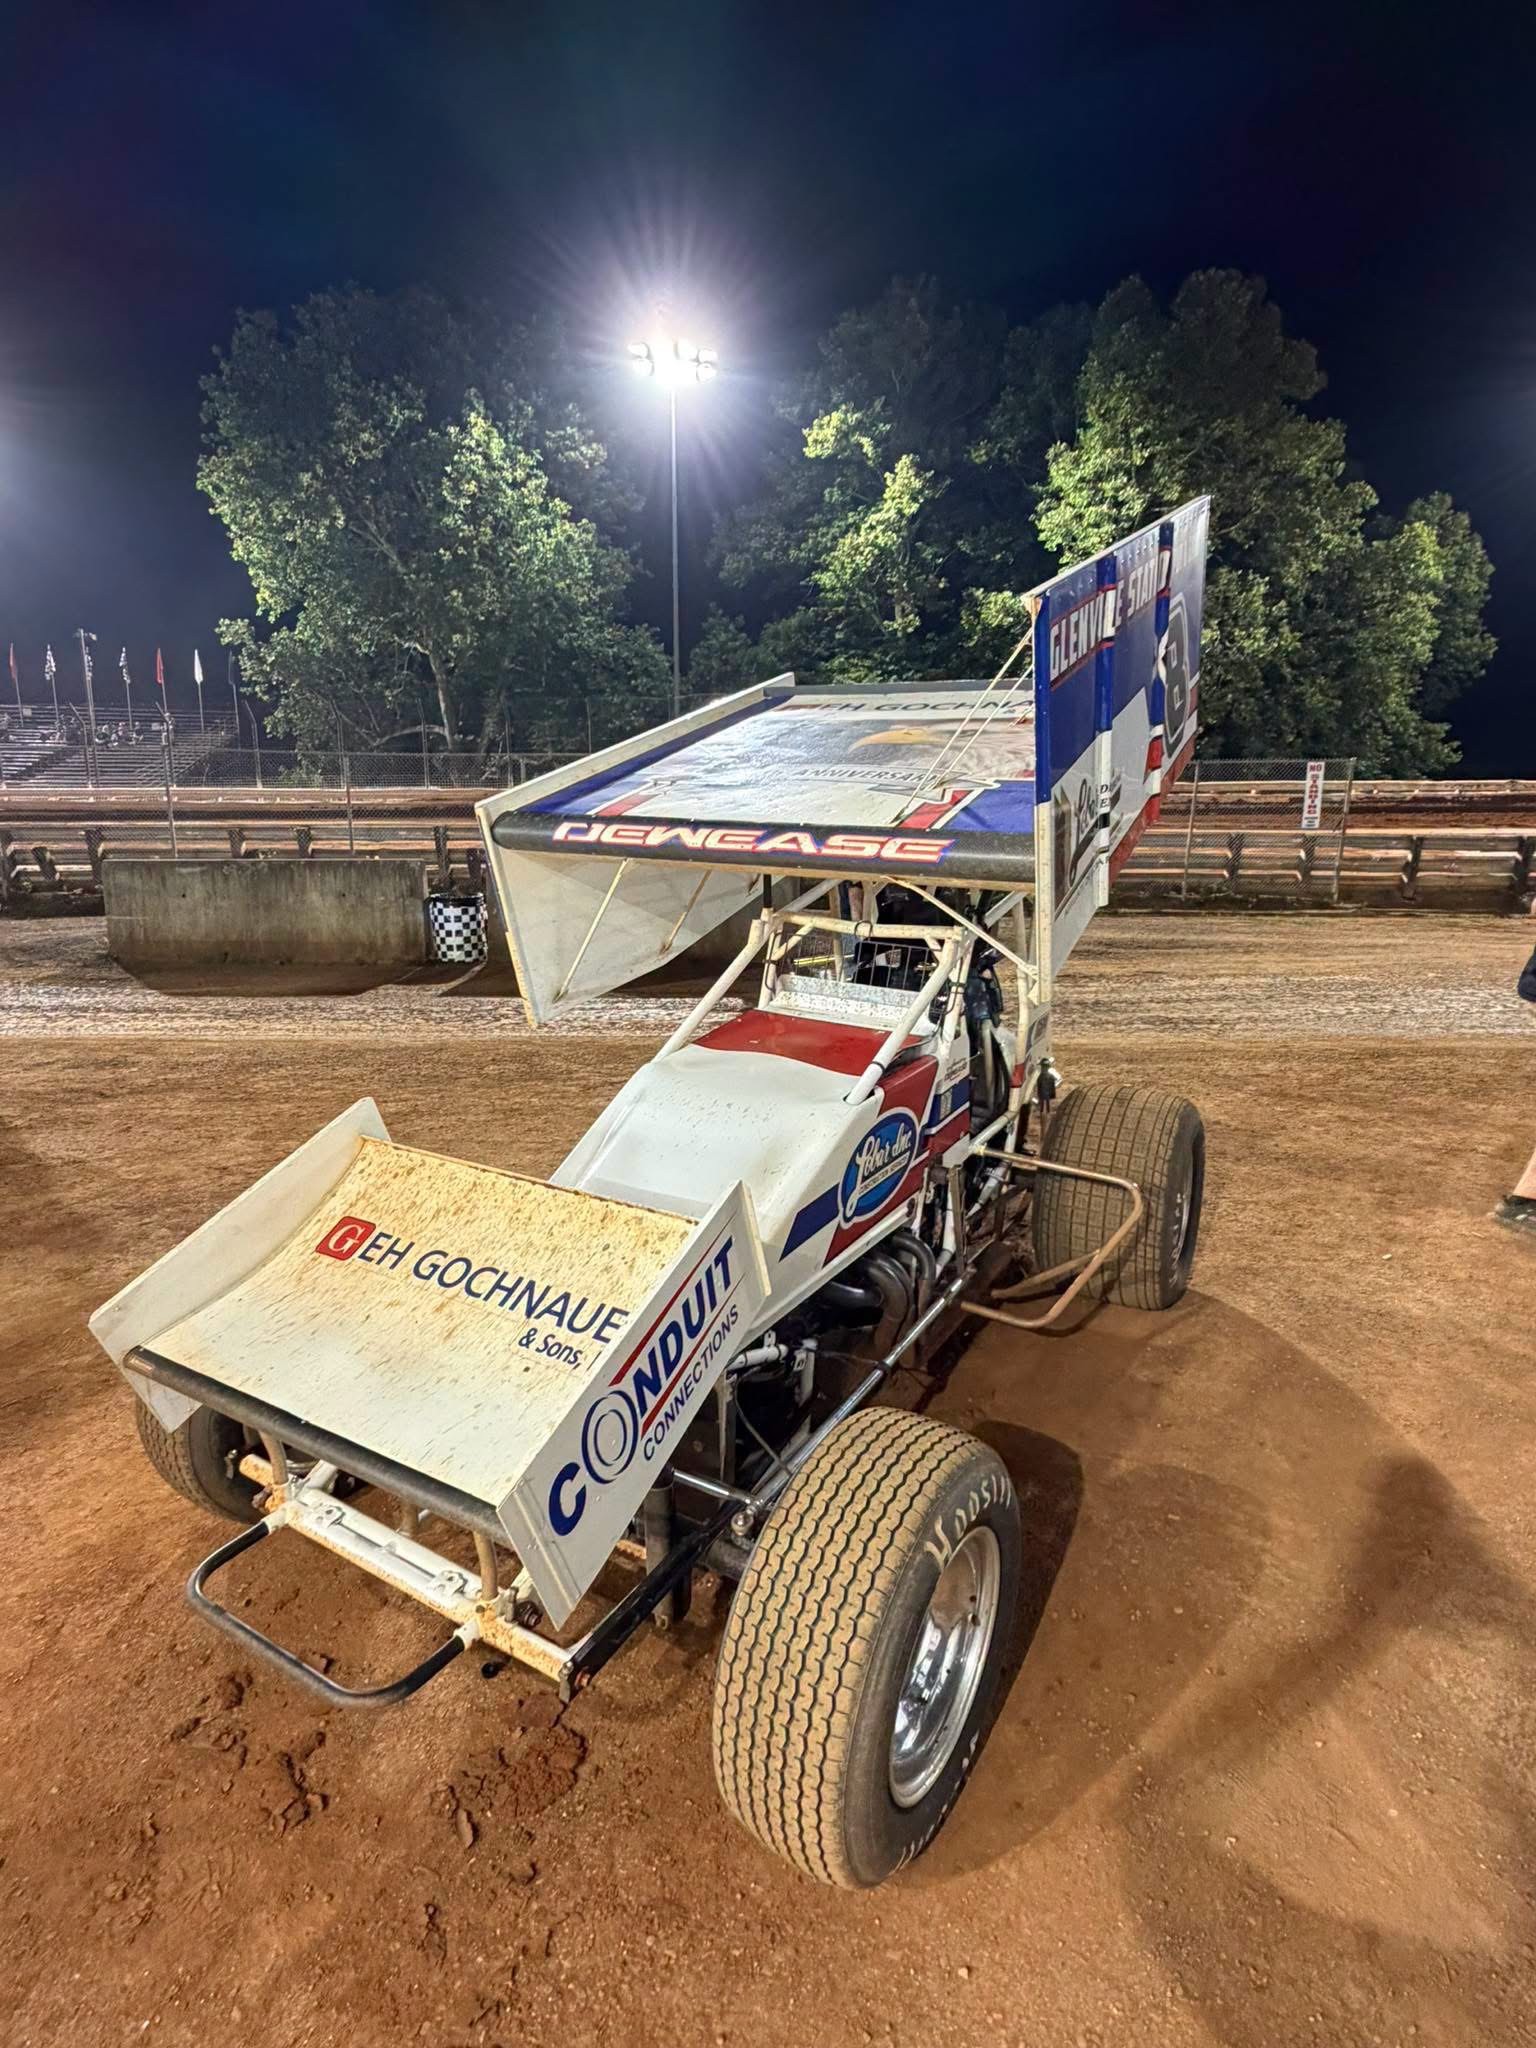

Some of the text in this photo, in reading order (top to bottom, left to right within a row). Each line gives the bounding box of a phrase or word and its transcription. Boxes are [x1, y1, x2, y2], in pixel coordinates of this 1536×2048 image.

[1050, 579, 1125, 682] GLENVILE
[1310, 764, 1322, 772] NO
[552, 821, 957, 864] DEWEASE
[357, 1231, 415, 1270] EH
[412, 1249, 630, 1344] GOCHNAUE
[518, 1327, 538, 1349] &
[535, 1333, 584, 1370] Sons,
[548, 1236, 733, 1537] CONDUIT
[642, 1303, 738, 1461] CONNECTIONS
